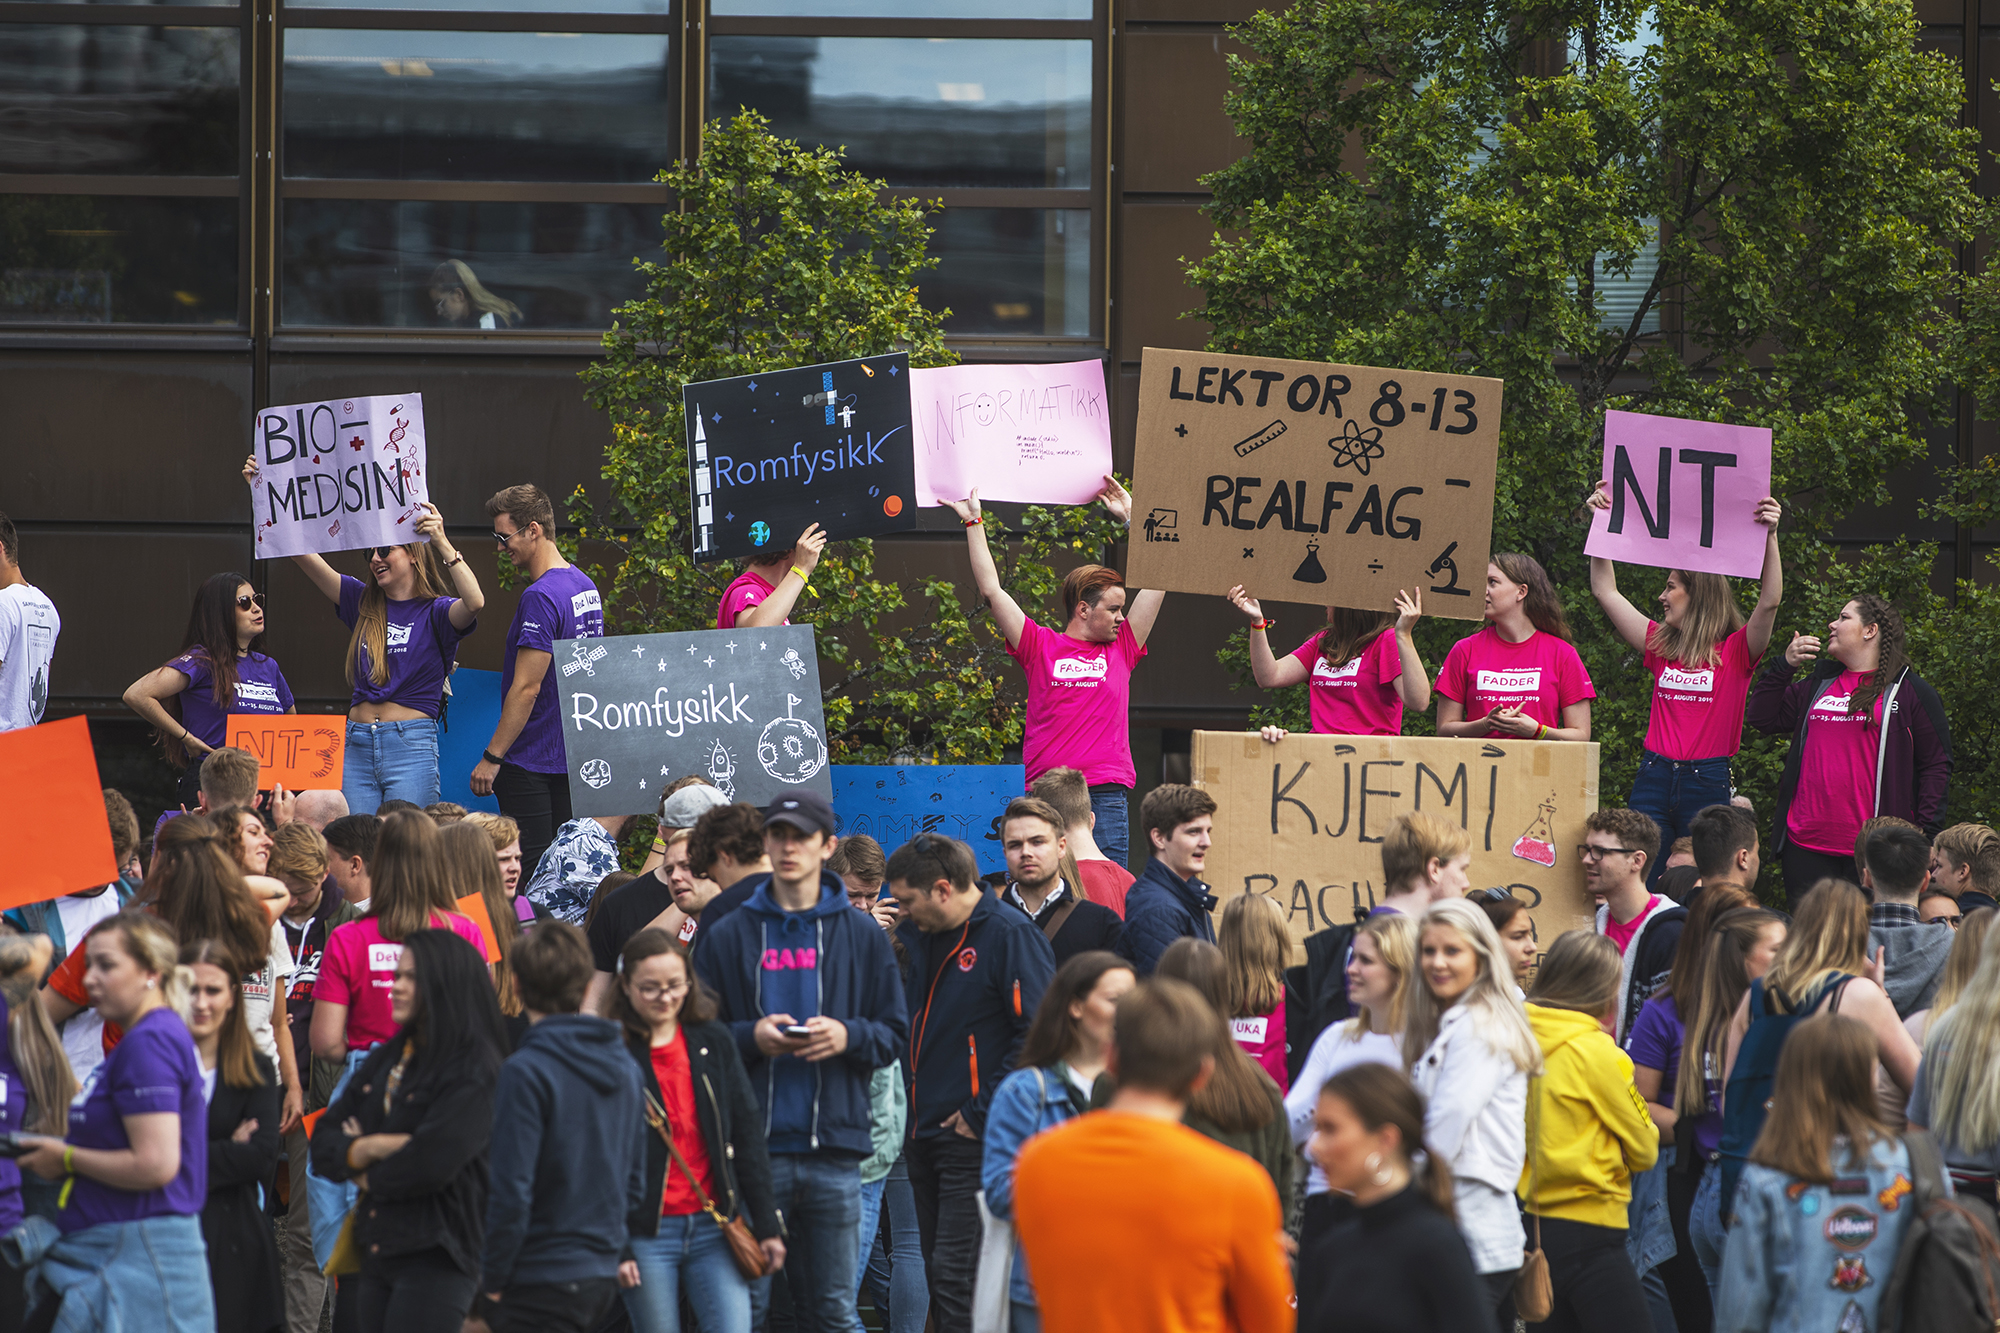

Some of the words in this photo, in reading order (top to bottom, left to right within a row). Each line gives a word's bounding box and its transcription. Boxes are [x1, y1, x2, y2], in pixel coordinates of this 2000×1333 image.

[1170, 366, 1351, 418] LEKTOR
[1369, 379, 1478, 435] 8-13
[264, 404, 369, 465] BIO-
[714, 423, 908, 488] Romfysikk
[267, 457, 405, 525] MEDISIN
[1202, 474, 1424, 541] REALFAG
[1607, 444, 1738, 549] NT
[387, 631, 406, 641] DER
[1482, 675, 1535, 687] FADDER
[1662, 671, 1708, 686] FADDER
[1673, 694, 1697, 702] AUGUST
[1698, 696, 1714, 704] 2019
[571, 682, 754, 738] Romfysikk
[236, 728, 341, 778] NT-3
[1236, 1021, 1261, 1035] UKA
